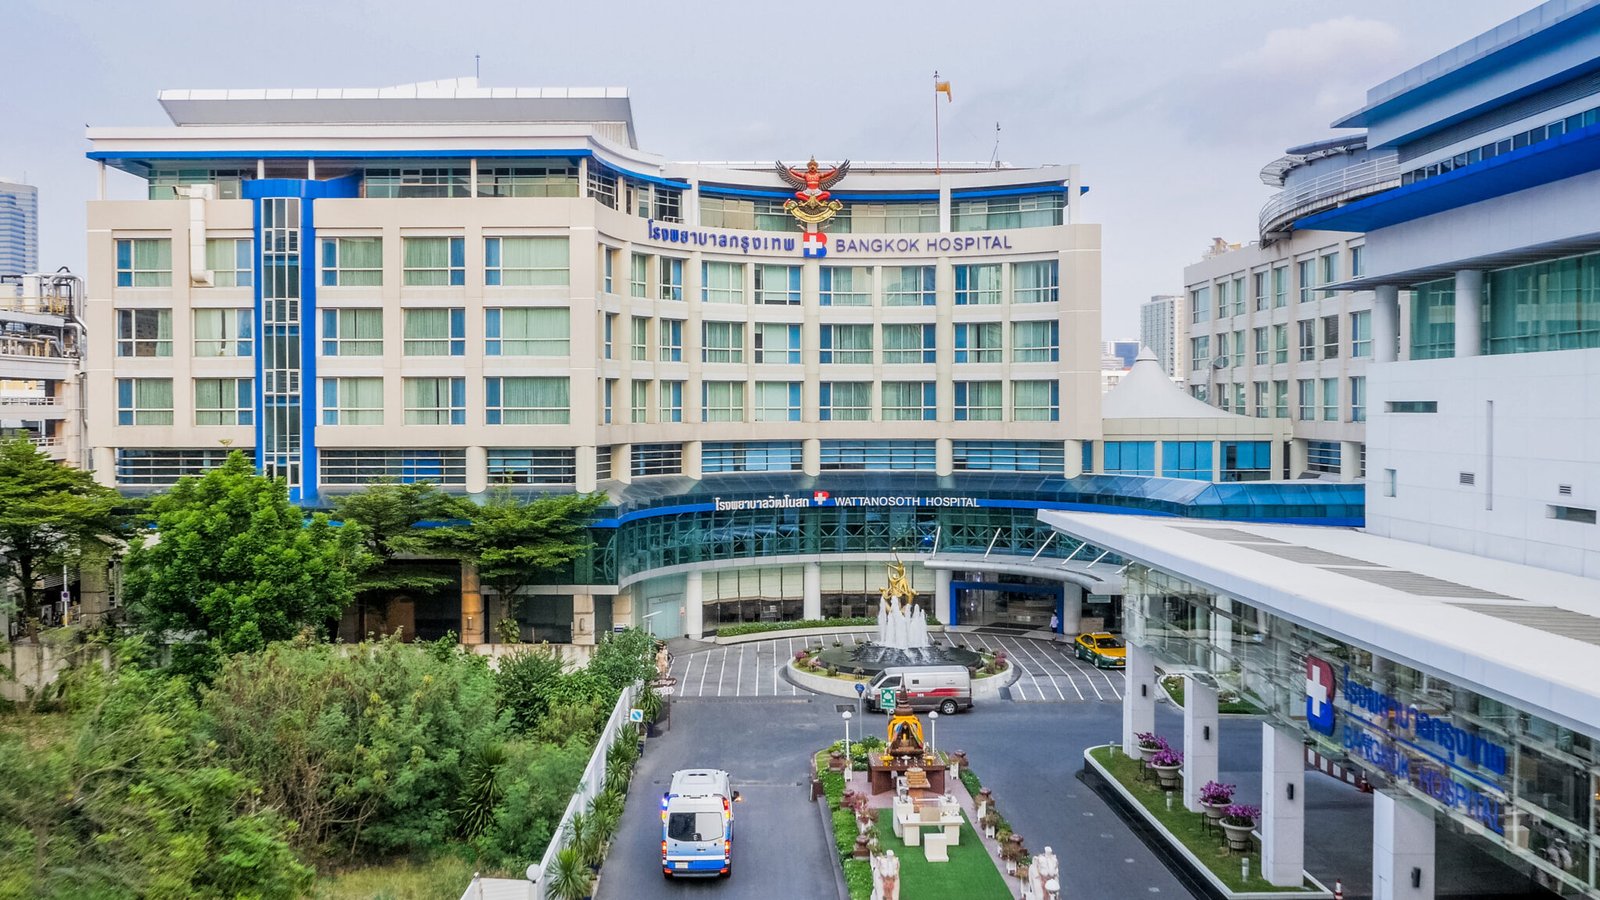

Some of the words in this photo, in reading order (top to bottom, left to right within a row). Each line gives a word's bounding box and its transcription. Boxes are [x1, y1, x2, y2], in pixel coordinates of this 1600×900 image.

[647, 219, 795, 253] โรงพยาบาลกรุงเทพ
[835, 237, 920, 252] BANGKOK
[926, 235, 1013, 251] HOSPITAL
[834, 496, 921, 507] WATTANOSOTH
[925, 496, 980, 508] HOSPITAL
[1418, 764, 1505, 837] HOSPITAL
